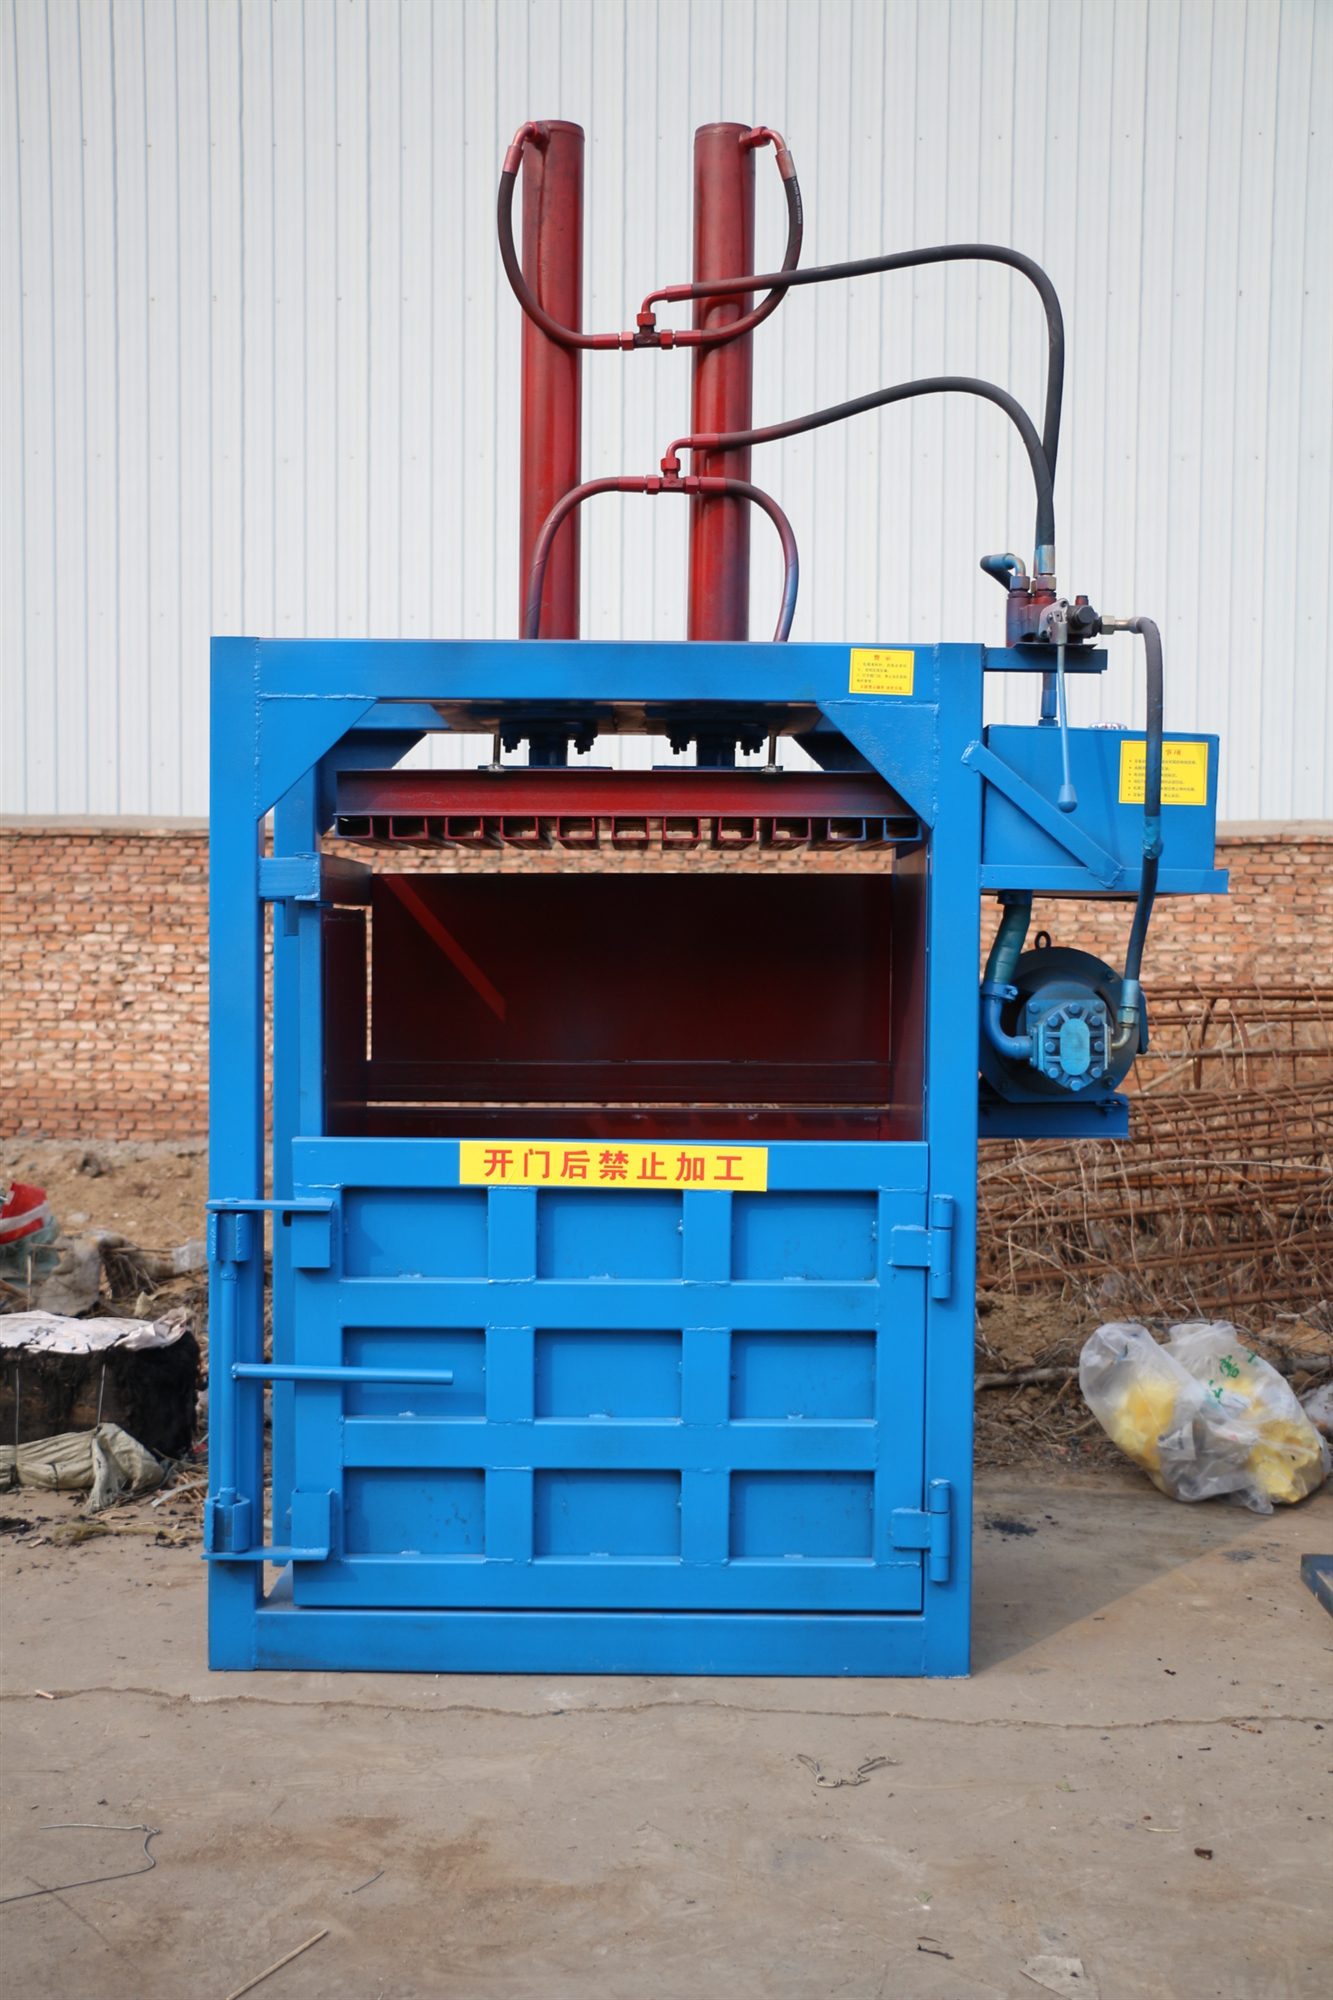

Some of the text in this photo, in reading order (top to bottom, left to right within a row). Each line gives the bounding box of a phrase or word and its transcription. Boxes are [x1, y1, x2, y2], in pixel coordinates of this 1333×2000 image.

[484, 1149, 743, 1181] 开门后禁止加工
